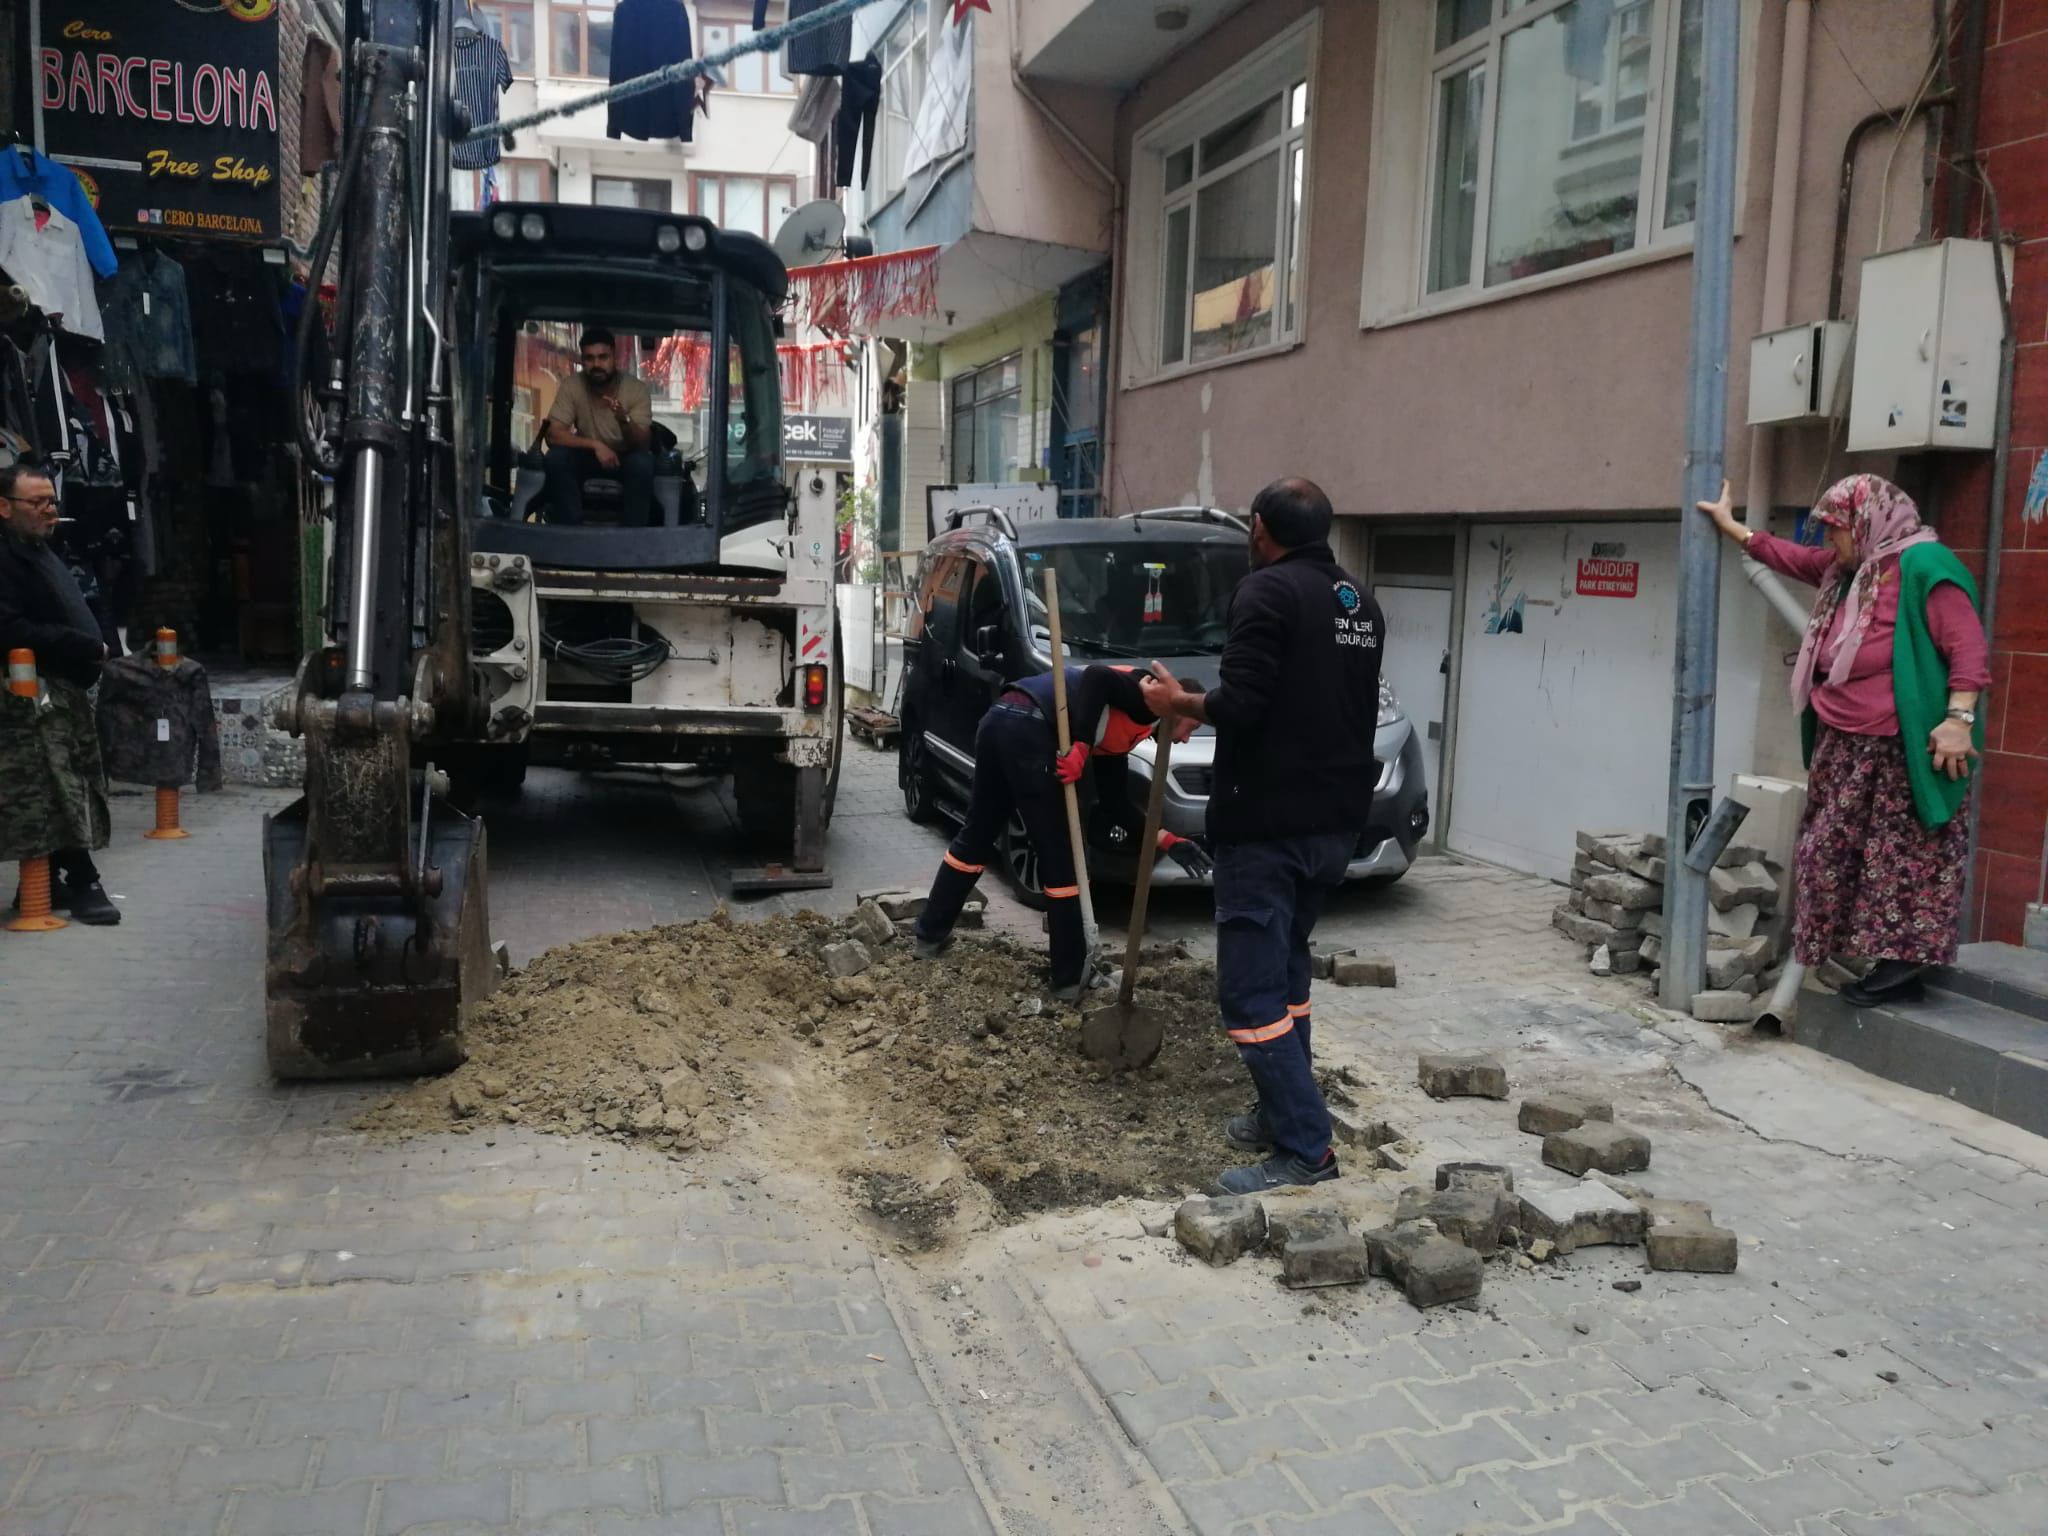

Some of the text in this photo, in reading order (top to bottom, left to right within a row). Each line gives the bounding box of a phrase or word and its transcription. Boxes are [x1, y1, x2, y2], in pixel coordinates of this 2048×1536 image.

[63, 20, 113, 41] Cero
[40, 47, 277, 132] BARCELONA
[147, 150, 200, 177] Free
[212, 156, 271, 187] Shop
[164, 209, 263, 234] CERO BARCELONA
[1579, 578, 1597, 591] PARK
